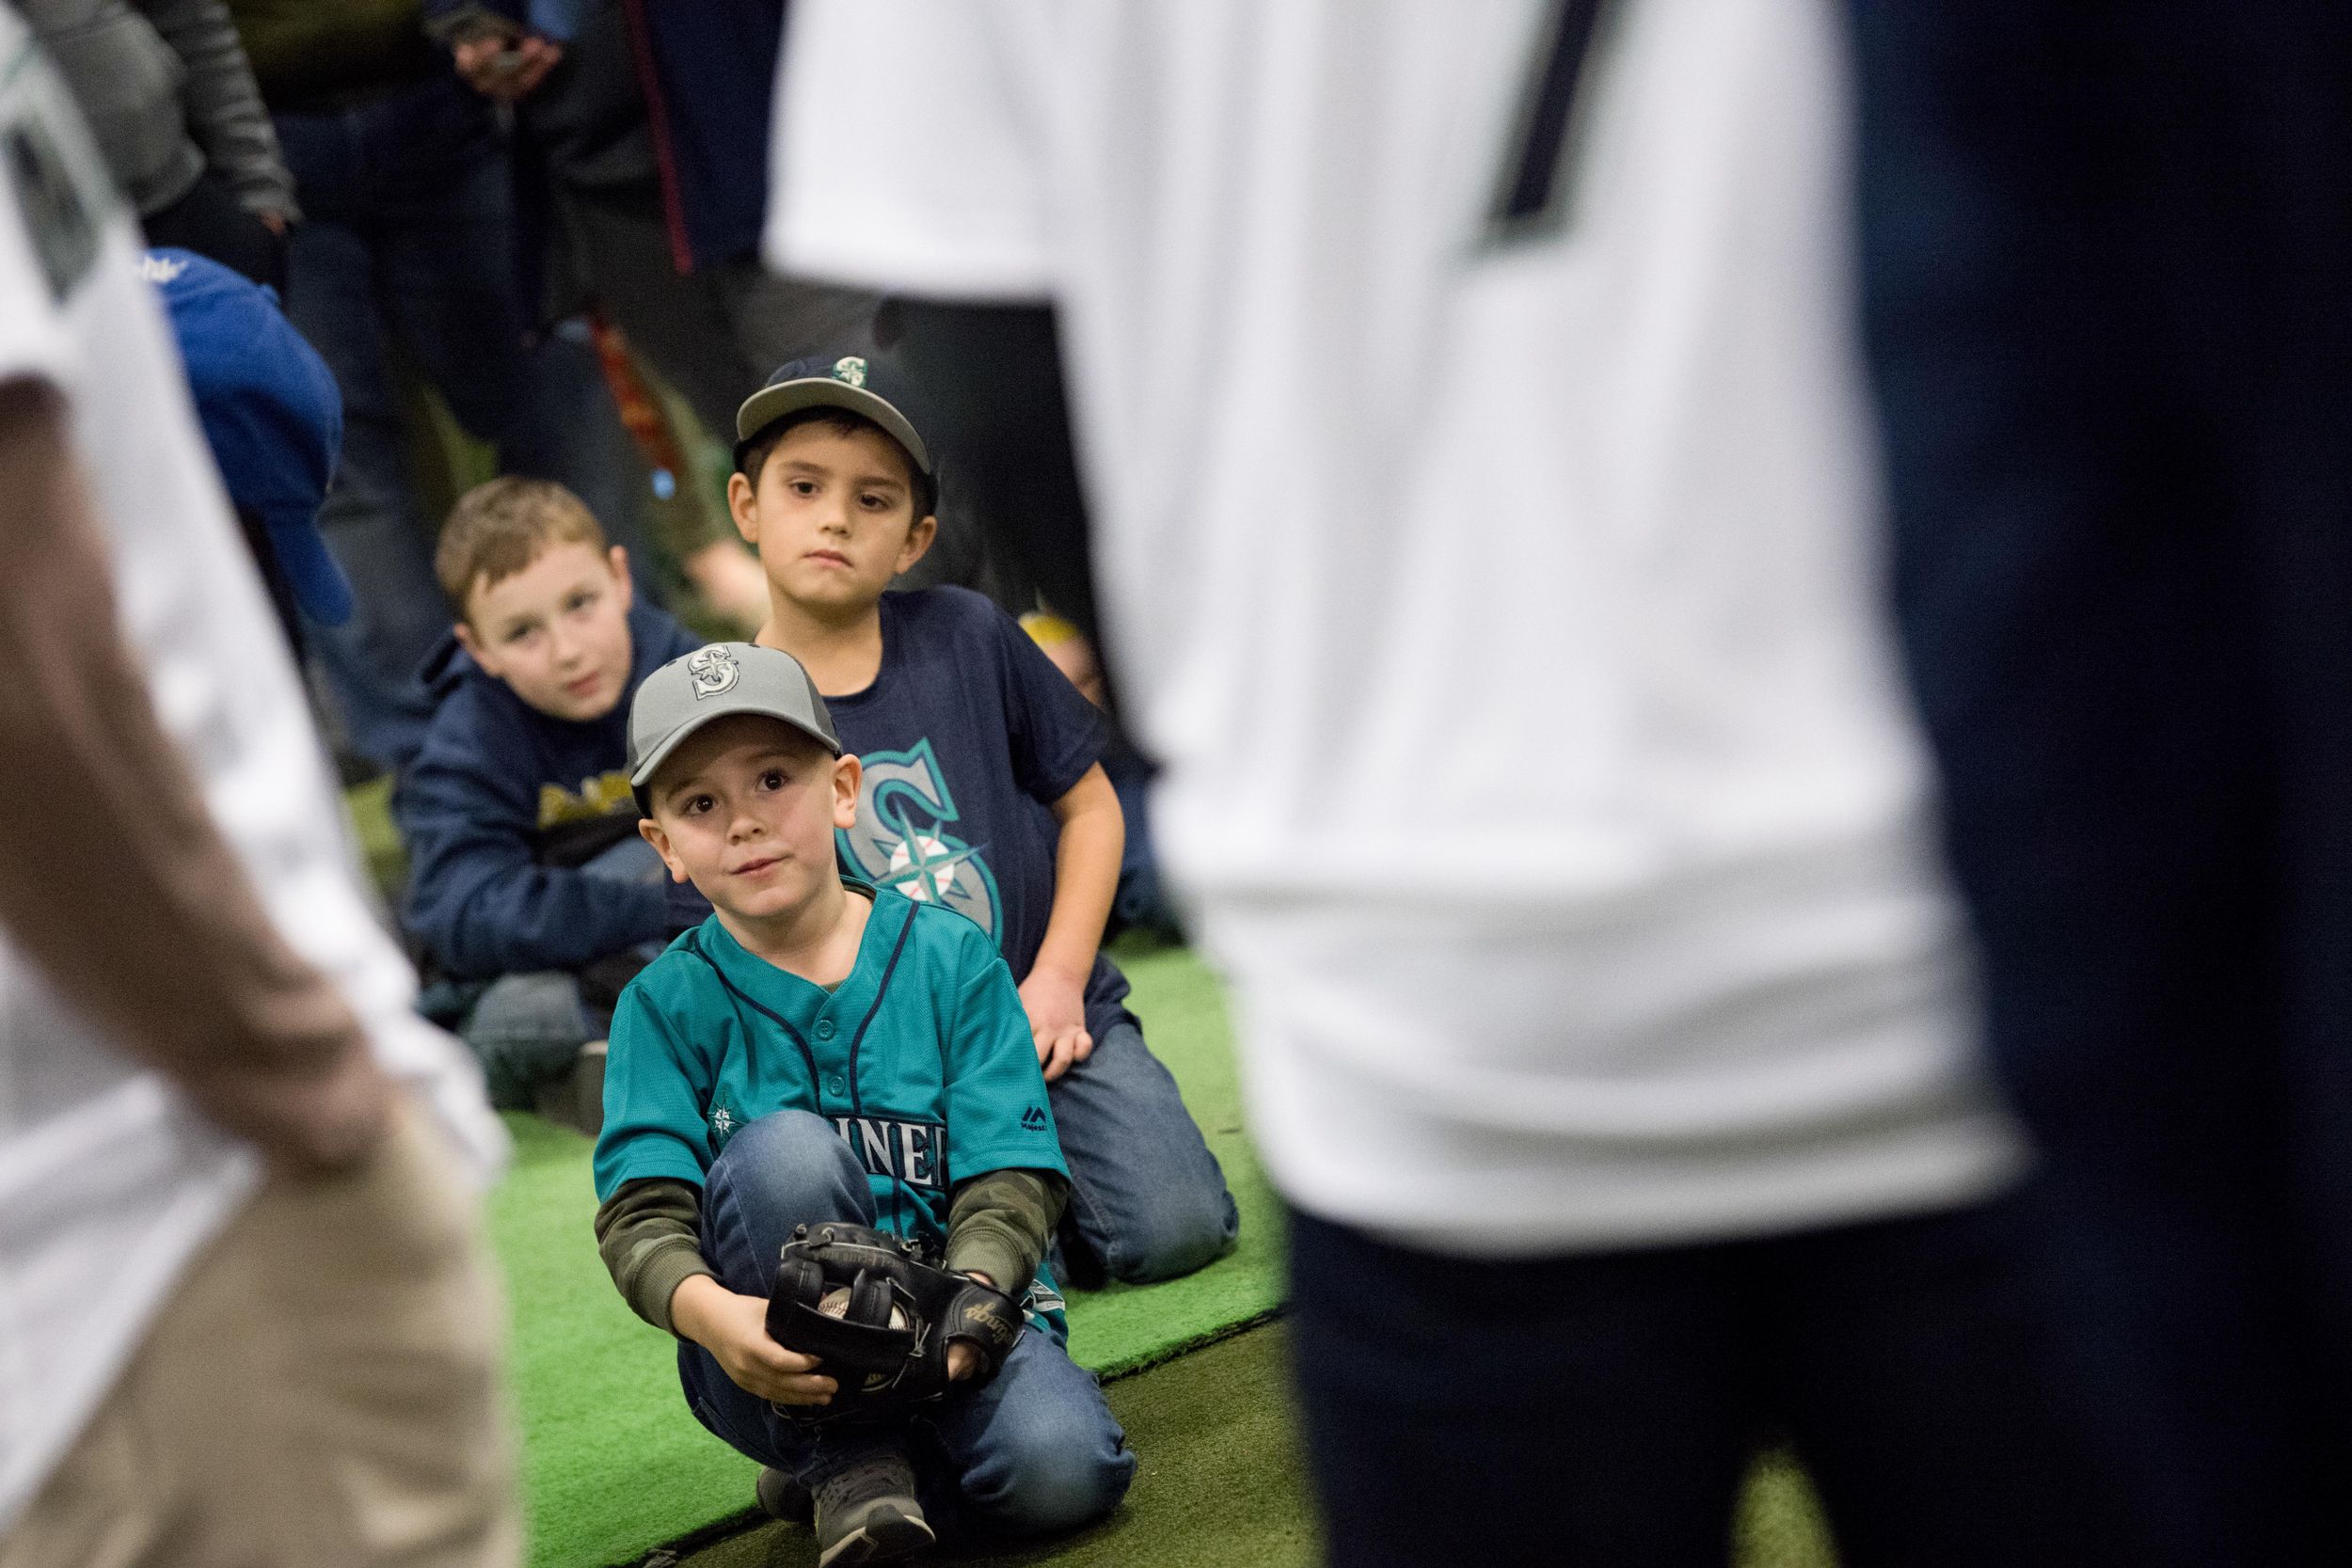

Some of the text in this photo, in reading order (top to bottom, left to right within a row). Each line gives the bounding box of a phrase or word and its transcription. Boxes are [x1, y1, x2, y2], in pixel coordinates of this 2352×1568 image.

[688, 643, 739, 701] S
[834, 736, 1004, 948] S
[834, 1116, 947, 1187] INE
